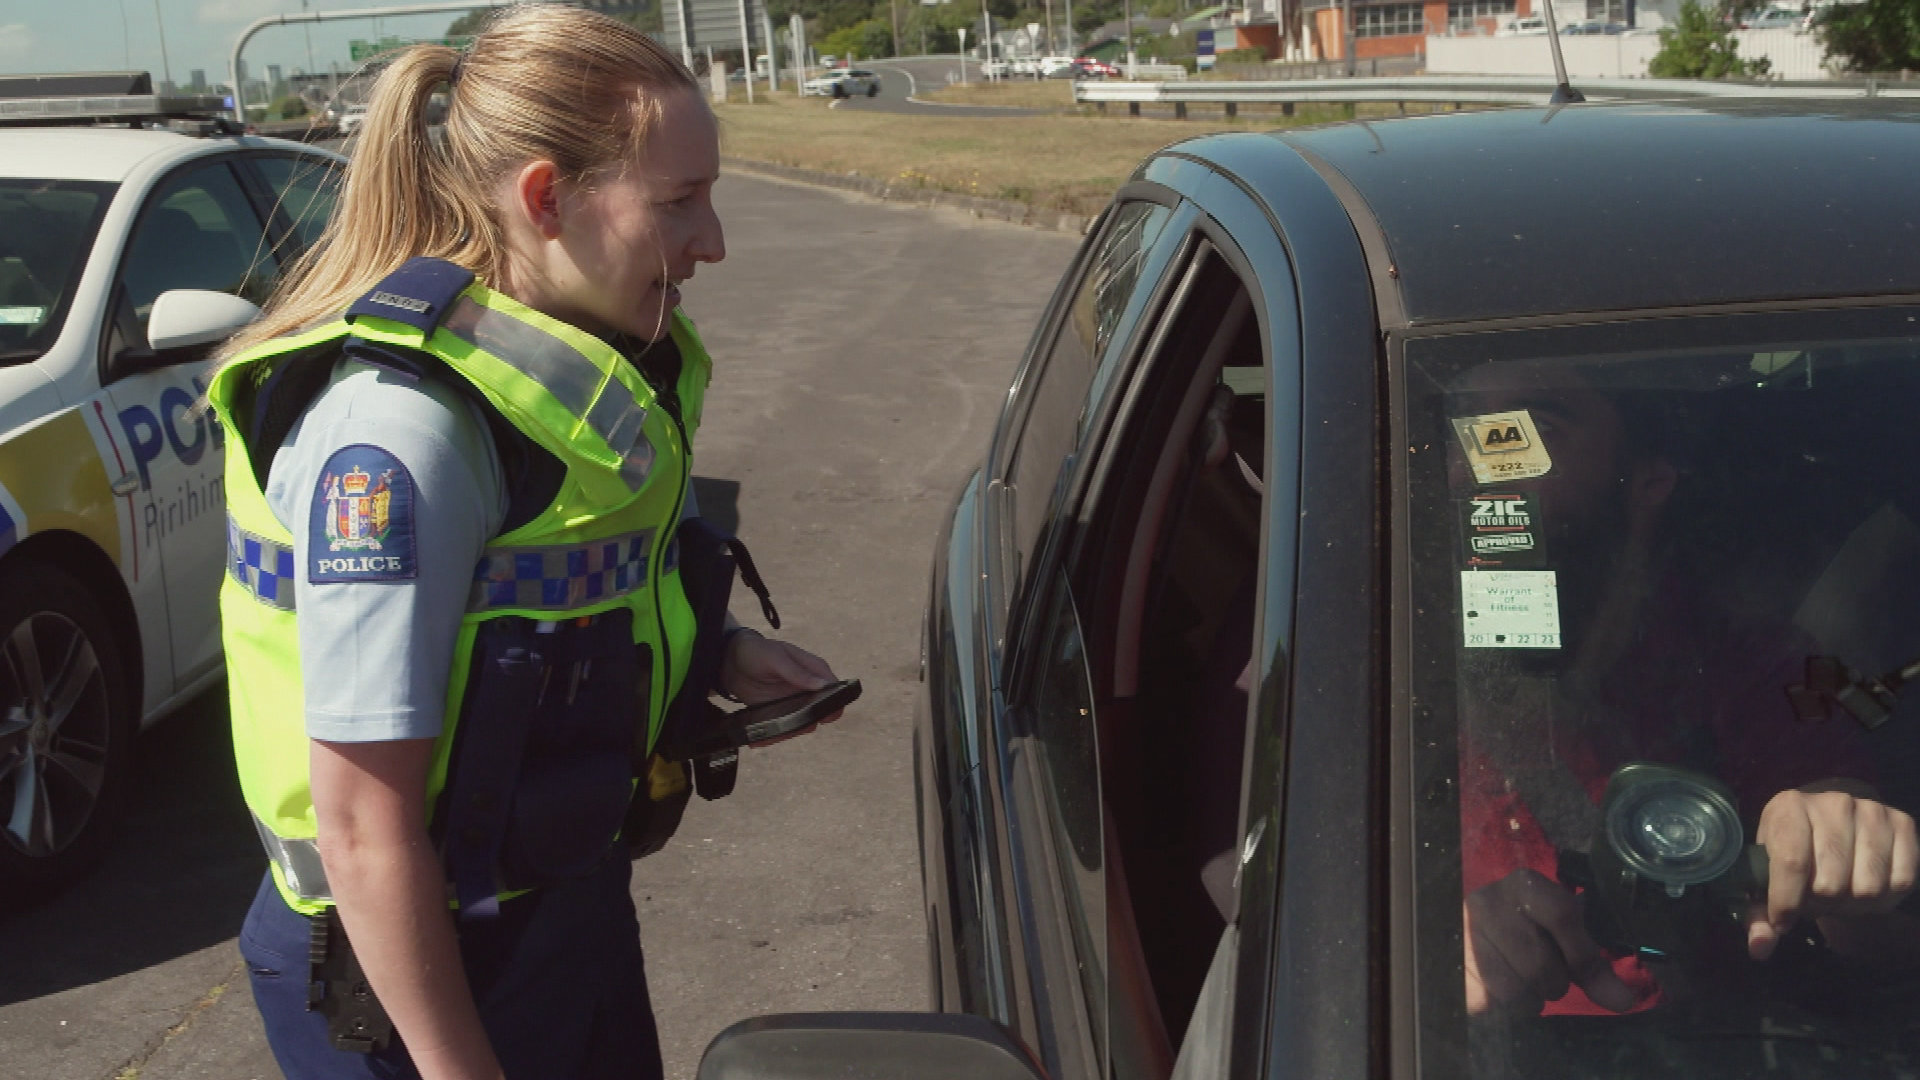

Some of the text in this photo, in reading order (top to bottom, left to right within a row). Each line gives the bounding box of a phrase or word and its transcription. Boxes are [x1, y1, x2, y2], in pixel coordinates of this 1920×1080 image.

[1485, 426, 1522, 446] AA
[1470, 500, 1529, 516] ZIC
[1470, 516, 1531, 526] MOTOR OILS
[1477, 536, 1529, 548] APPROVED
[317, 556, 402, 574] POLICE
[1486, 587, 1532, 596] Warrant
[1504, 596, 1515, 604] of
[1490, 604, 1530, 612] Fitness
[1469, 634, 1484, 644] 20
[1517, 634, 1531, 644] 22
